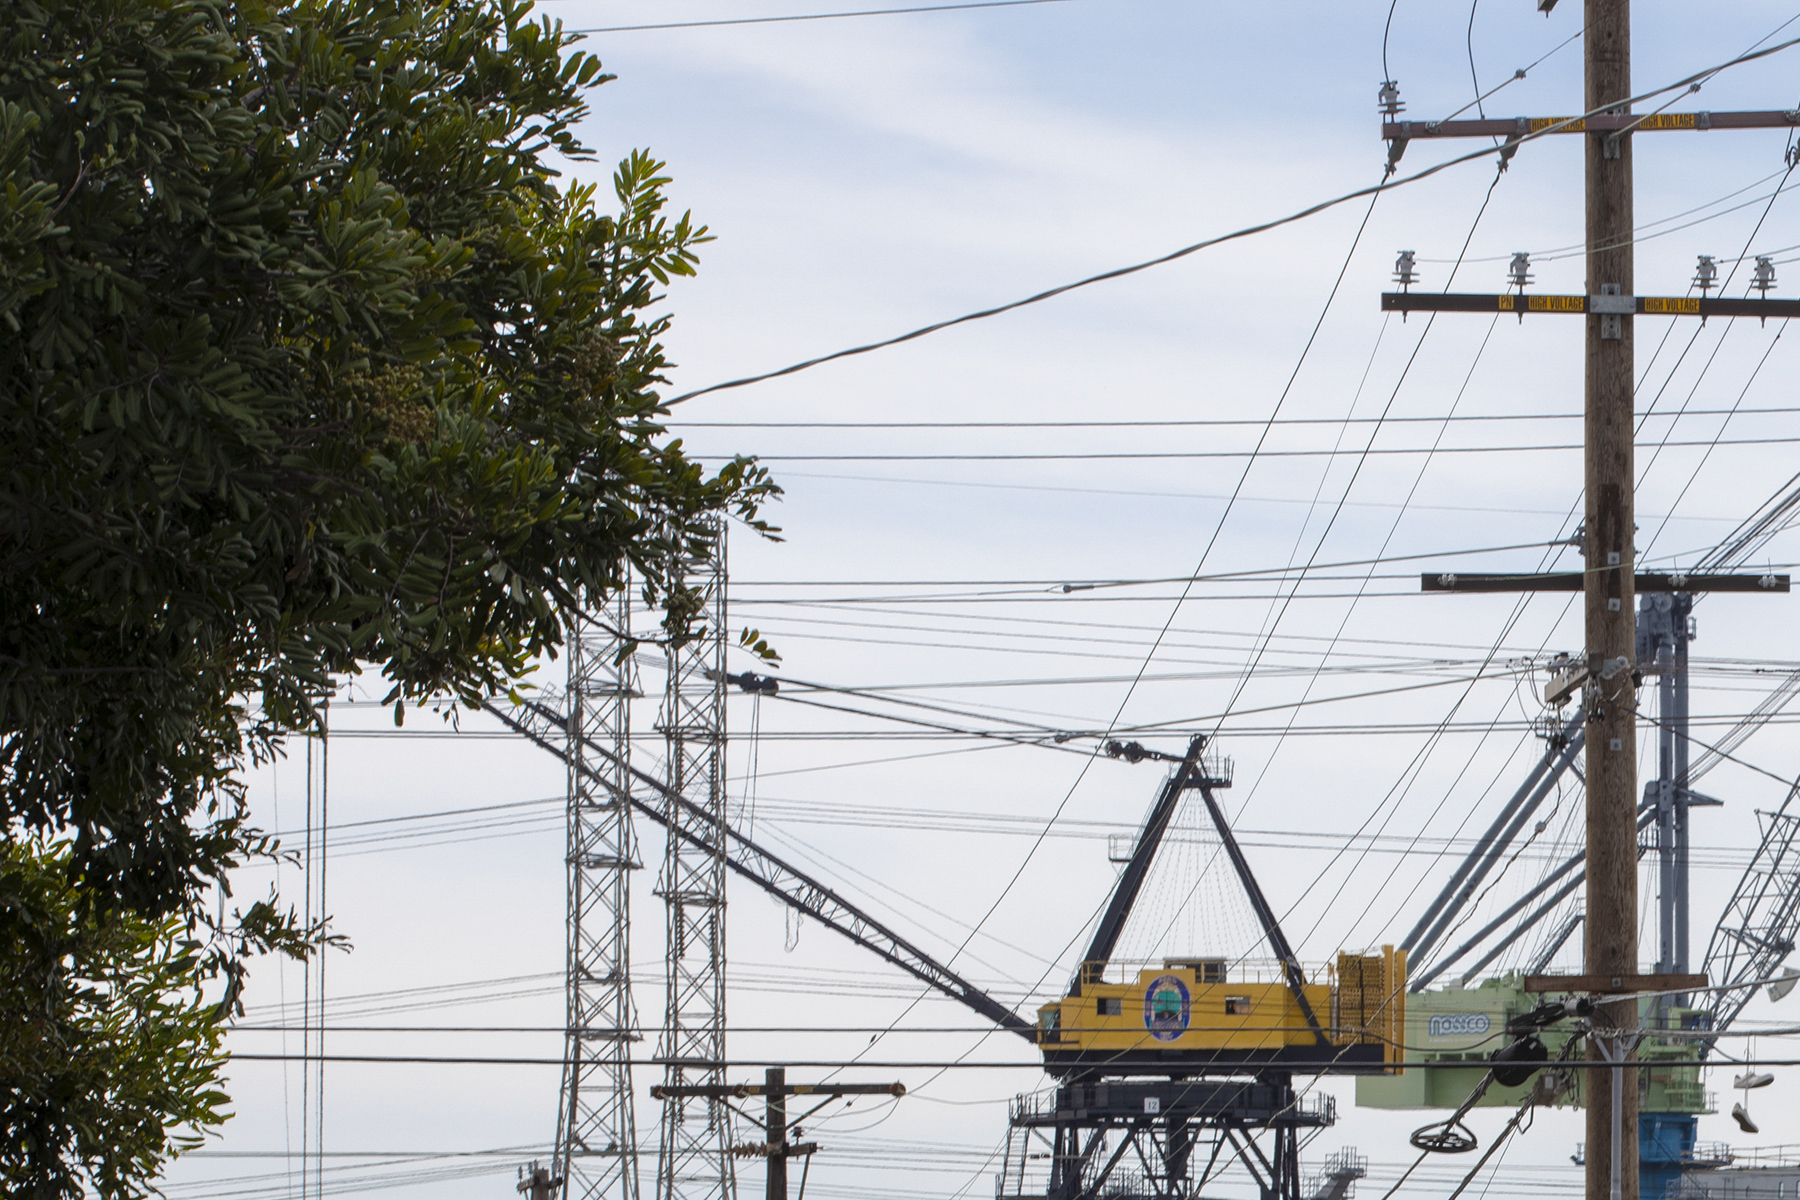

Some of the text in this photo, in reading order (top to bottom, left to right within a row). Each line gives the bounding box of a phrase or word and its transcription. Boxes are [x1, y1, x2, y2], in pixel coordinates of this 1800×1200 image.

[1661, 114, 1694, 127] VOLTAGE
[1530, 297, 1583, 310] HIGH VOLTAGE
[1646, 299, 1699, 311] HIGH VOLTAGE
